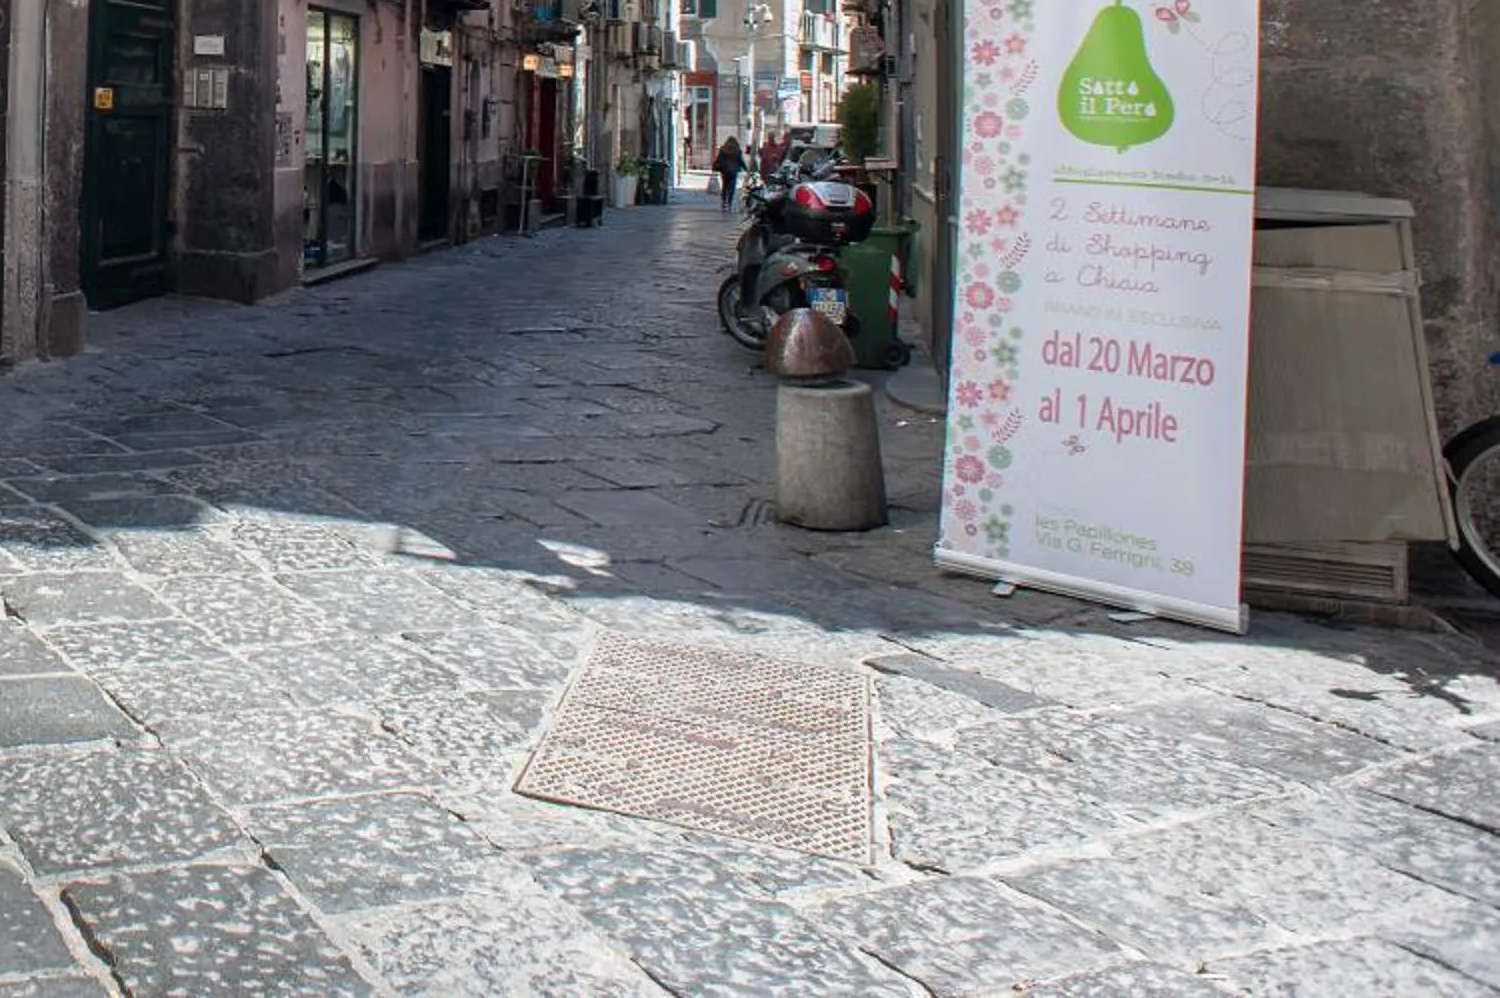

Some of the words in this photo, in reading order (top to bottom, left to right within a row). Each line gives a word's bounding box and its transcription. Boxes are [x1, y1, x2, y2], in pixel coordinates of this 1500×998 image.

[1079, 97, 1096, 115] il
[1050, 197, 1068, 221] 2
[1083, 201, 1212, 233] Settimane
[1045, 233, 1072, 253] di
[1085, 233, 1213, 275] Shopping
[1043, 270, 1065, 284] a
[1042, 330, 1081, 368] dal
[1088, 337, 1120, 373] 20
[1127, 340, 1215, 387] Marzo
[1039, 387, 1061, 424] al
[1076, 394, 1087, 429] 1
[1096, 396, 1178, 444] Aprile
[1035, 531, 1062, 549] Via
